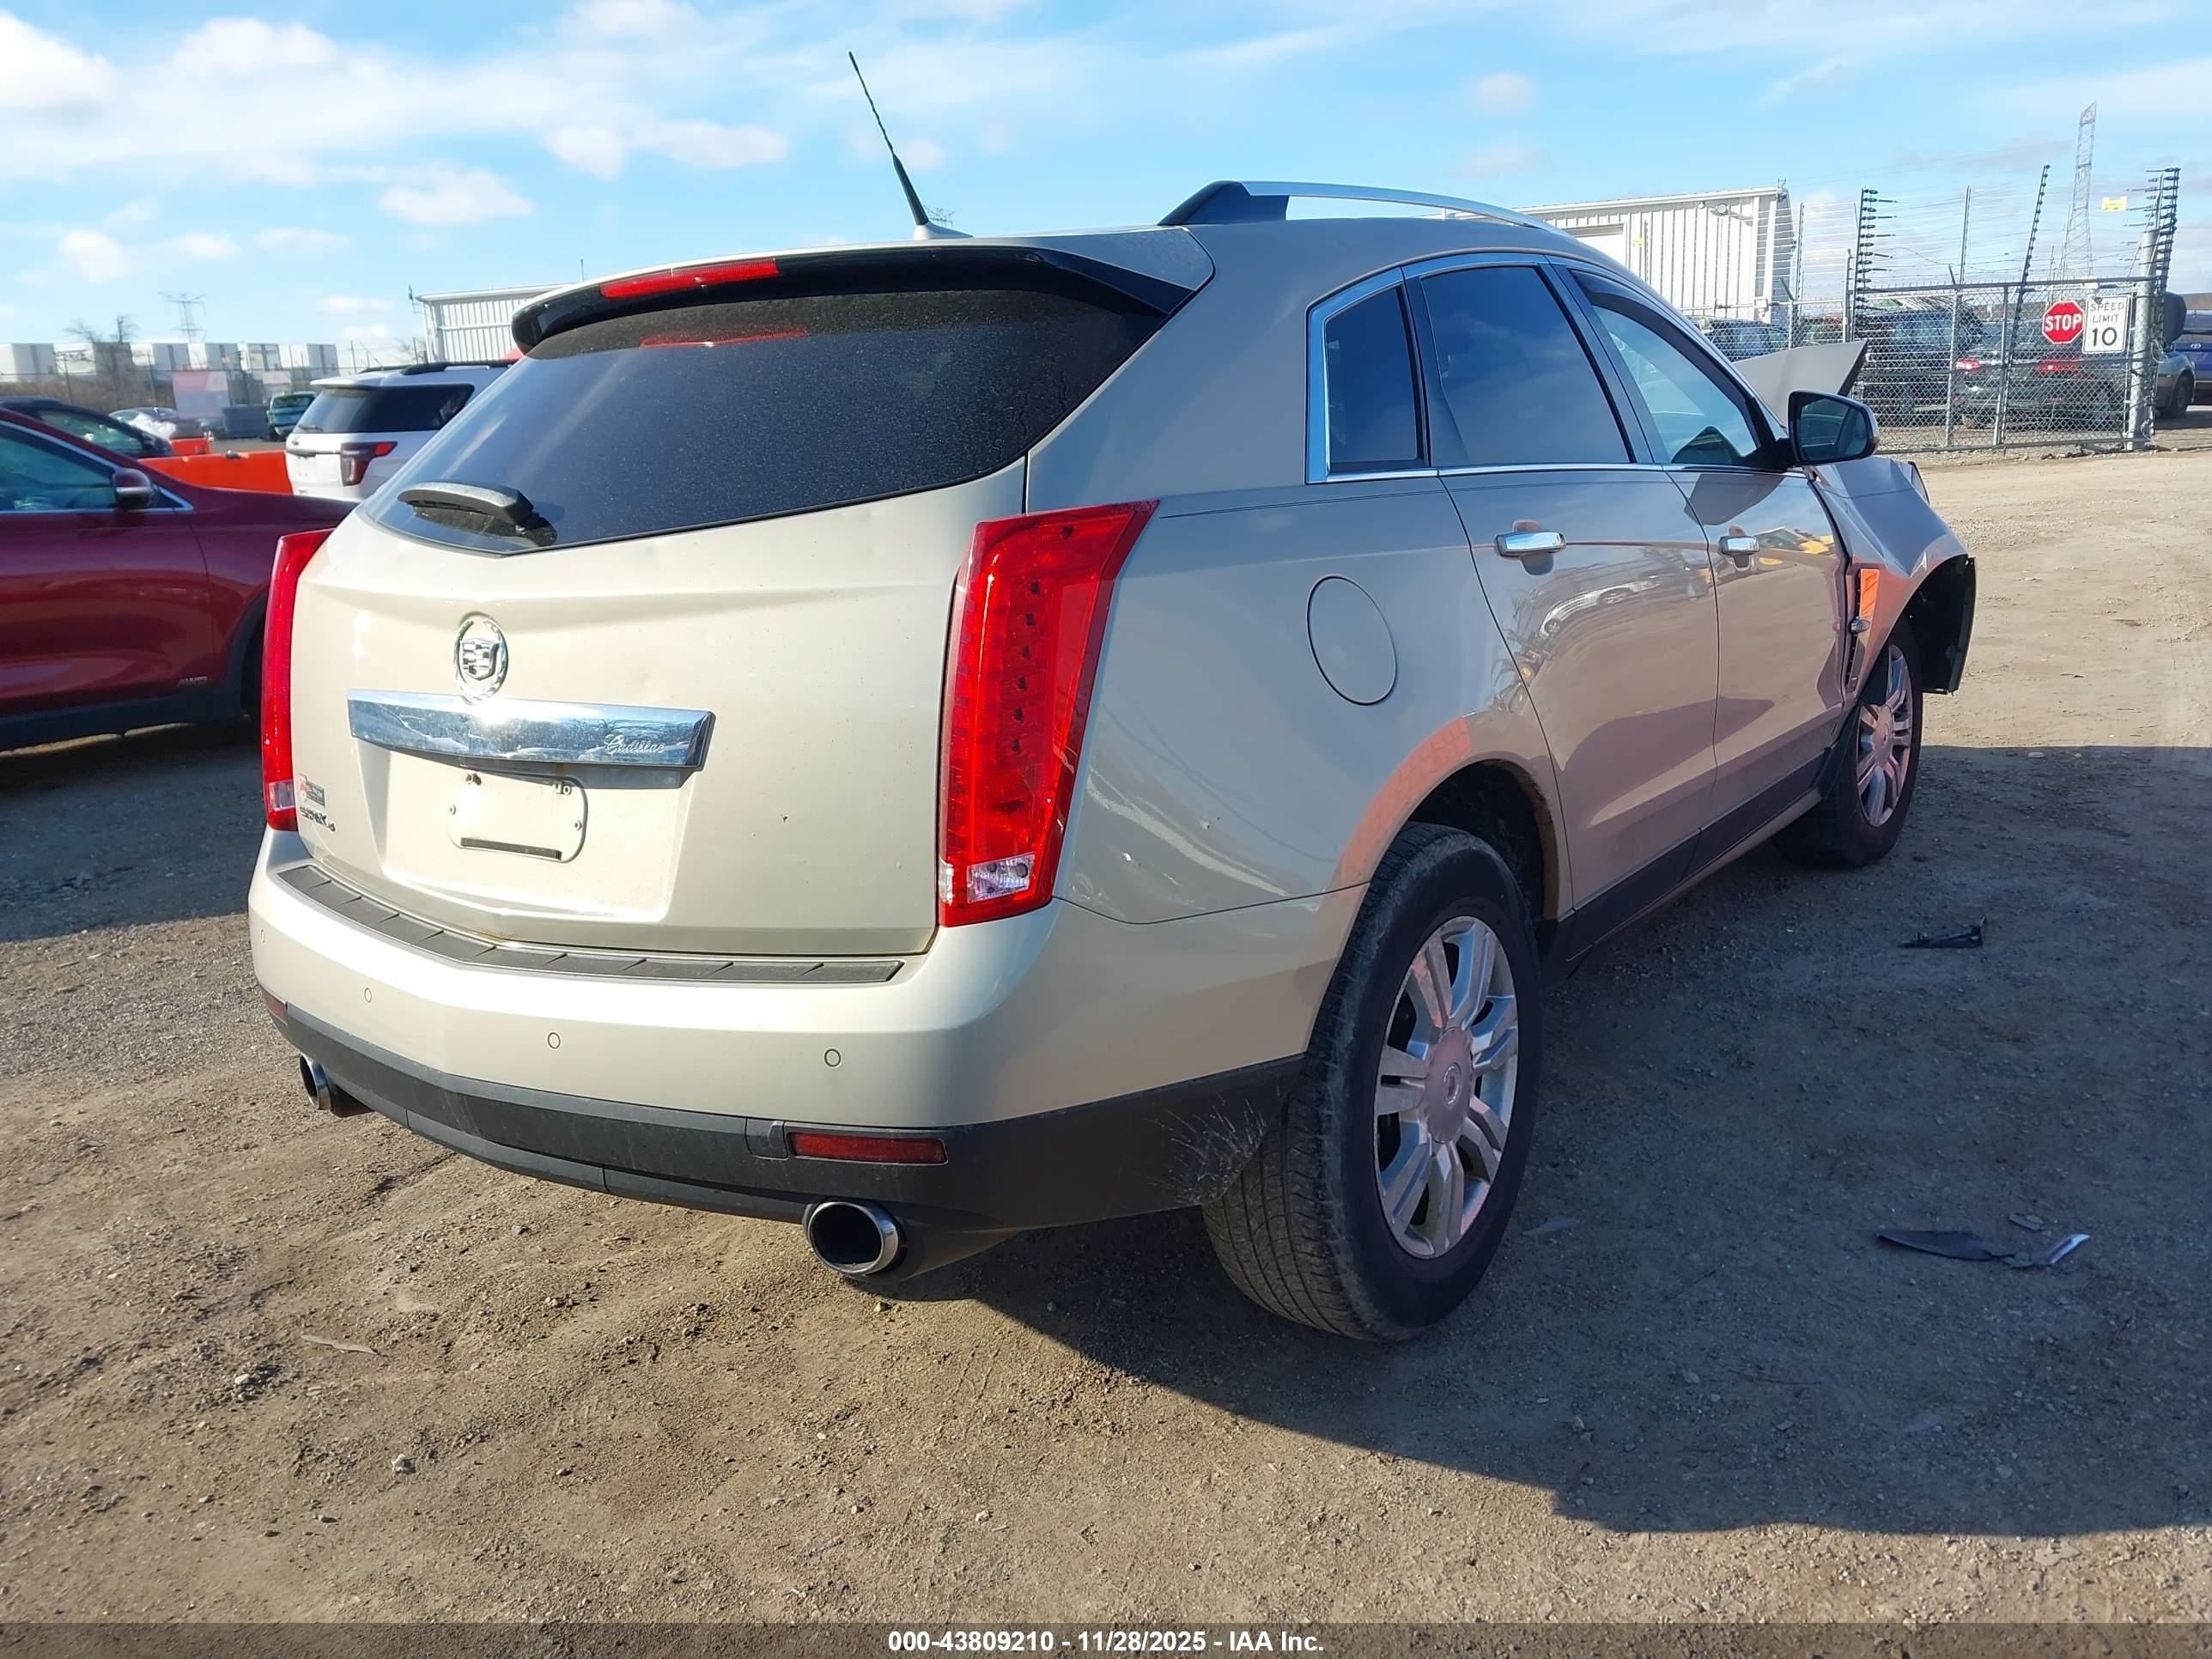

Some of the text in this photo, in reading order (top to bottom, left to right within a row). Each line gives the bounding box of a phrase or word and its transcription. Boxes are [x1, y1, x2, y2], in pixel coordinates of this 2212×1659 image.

[2090, 301, 2125, 312] SPEED
[2045, 313, 2082, 332] STOP
[2093, 314, 2119, 324] LIMIT
[2092, 327, 2118, 346] 10
[605, 734, 666, 756] Cadillac
